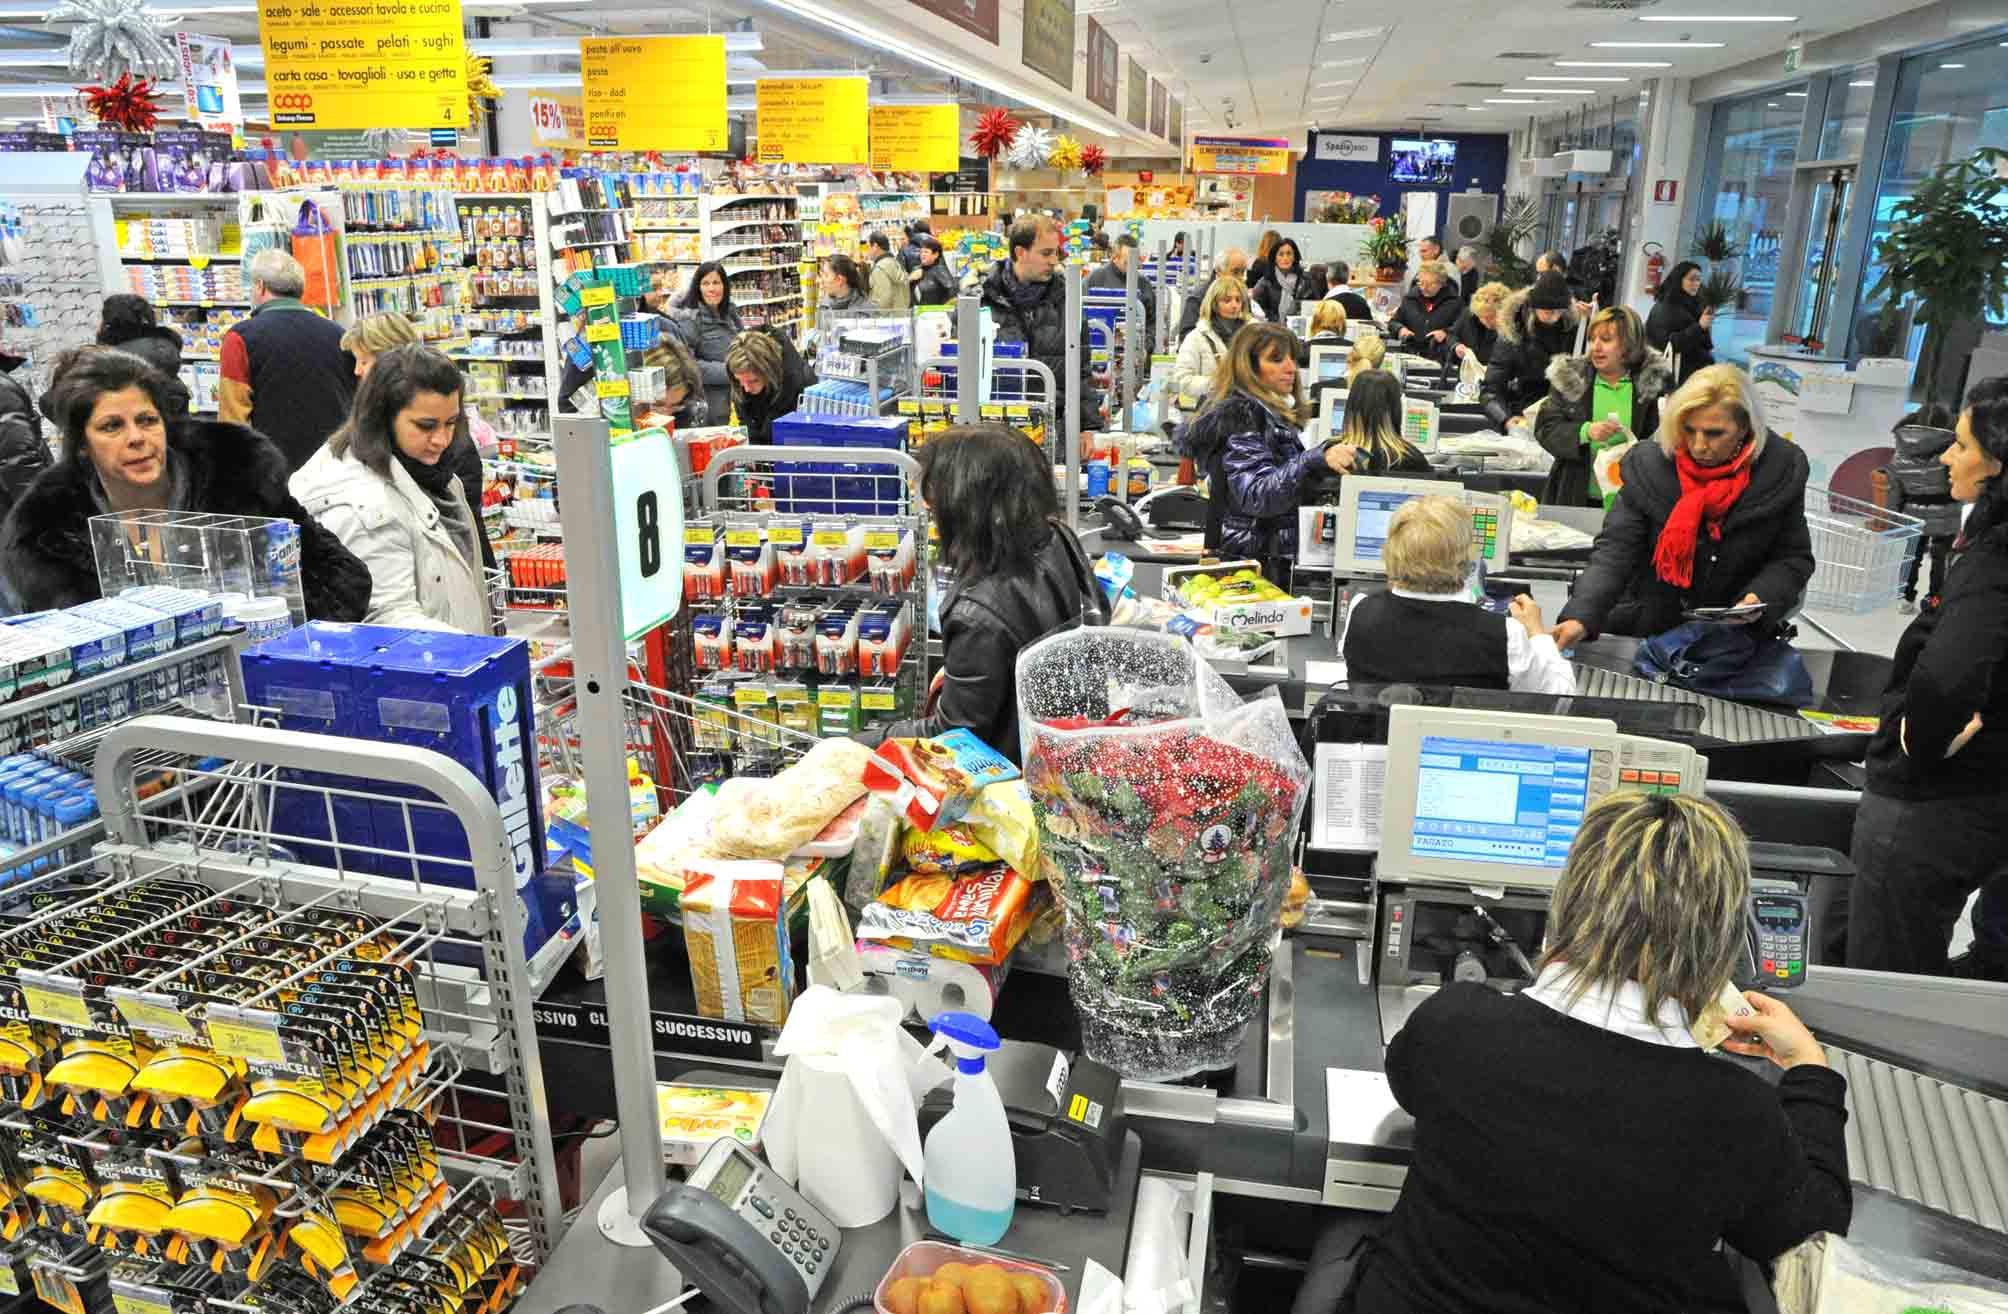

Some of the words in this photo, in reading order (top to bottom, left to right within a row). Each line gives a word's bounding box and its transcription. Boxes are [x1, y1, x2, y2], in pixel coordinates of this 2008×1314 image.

[265, 8, 292, 17] aceto
[301, 6, 320, 17] sale
[330, 4, 373, 16] accessori
[419, 2, 451, 13] cucina
[270, 37, 309, 53] legumi
[320, 38, 365, 52] passate
[377, 35, 410, 51] pelati
[423, 32, 454, 51] sughi
[273, 70, 301, 81] carta
[304, 71, 328, 81] casa
[337, 66, 387, 84] tovaglioli
[429, 68, 457, 84] getta
[274, 95, 313, 112] coop
[443, 108, 451, 120] 4
[533, 102, 561, 129] 15%
[636, 490, 661, 579] 8
[1231, 610, 1284, 627] Melinda
[534, 1010, 577, 1027] SSIVO
[655, 1019, 752, 1044] SUCCESSIVO
